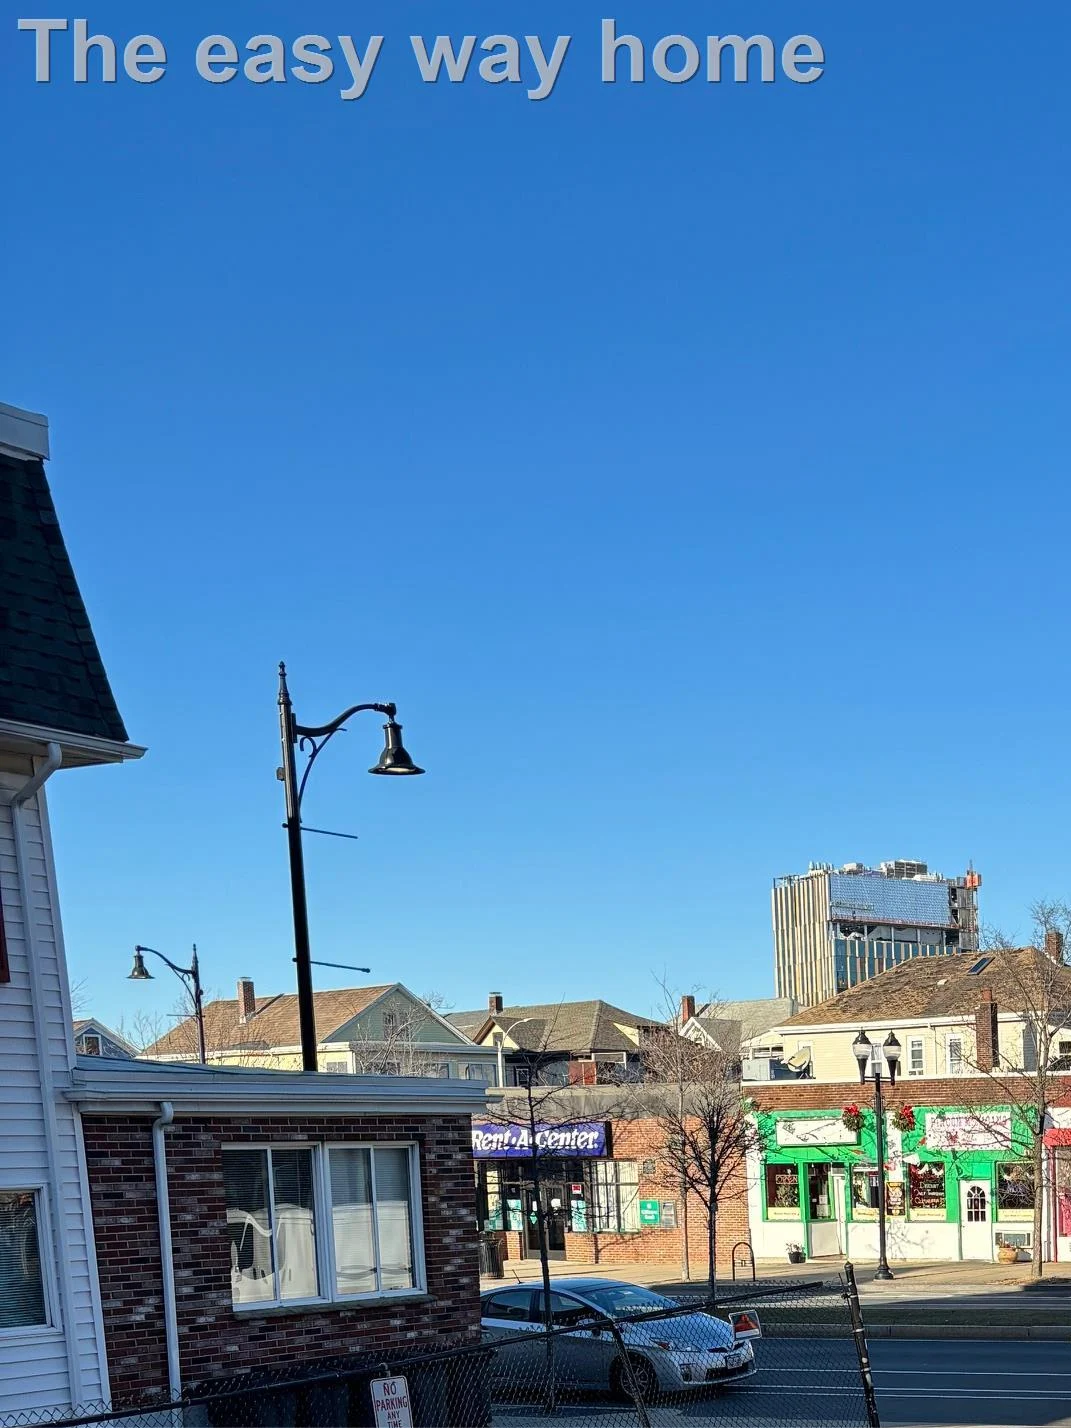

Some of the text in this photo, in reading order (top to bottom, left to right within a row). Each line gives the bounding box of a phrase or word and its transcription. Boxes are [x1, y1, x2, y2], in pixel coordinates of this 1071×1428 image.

[383, 1382, 397, 1396] NO
[375, 1396, 408, 1411] PARKING
[387, 1410, 400, 1420] ANY
